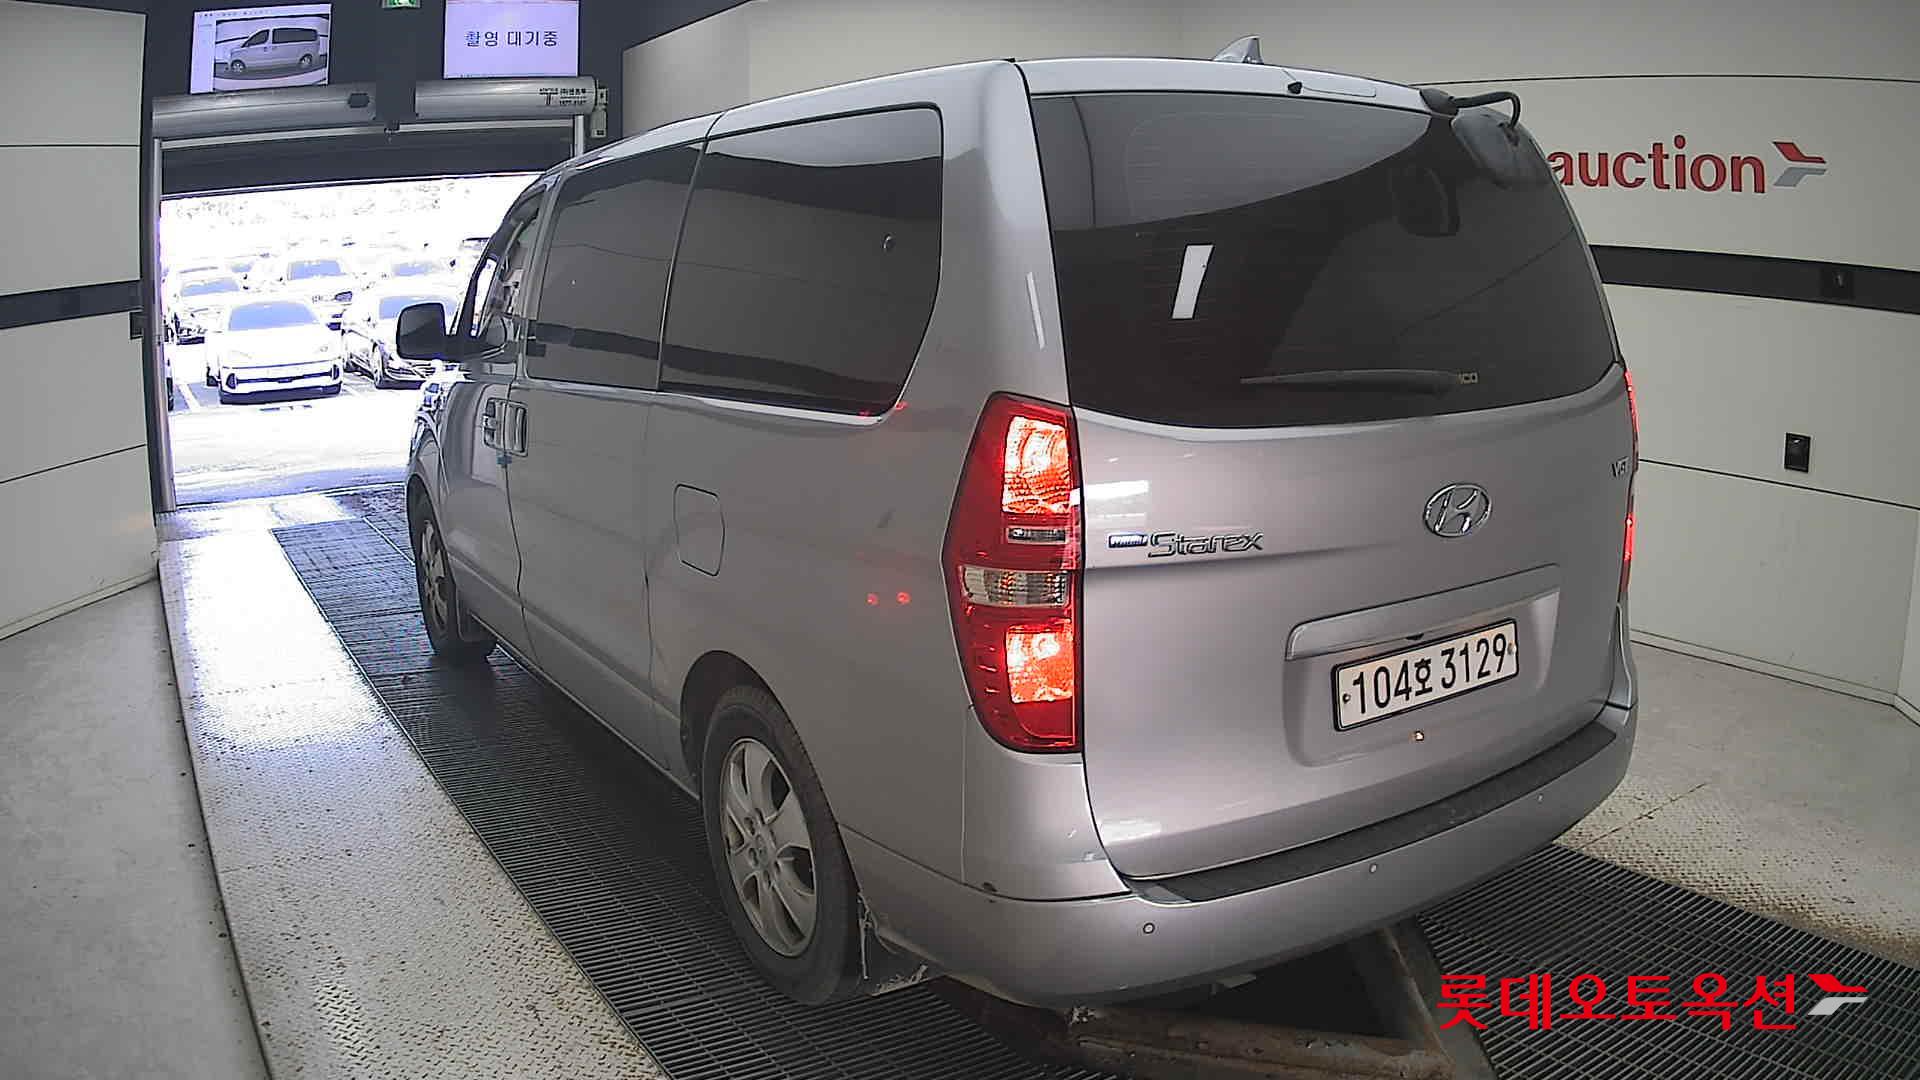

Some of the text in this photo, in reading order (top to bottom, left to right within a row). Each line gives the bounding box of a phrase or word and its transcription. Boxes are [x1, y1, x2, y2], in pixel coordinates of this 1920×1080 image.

[507, 31, 558, 47] 대기중
[1547, 134, 1766, 194] auction
[1148, 531, 1264, 558] Starex
[1352, 632, 1507, 714] 104호 3129
